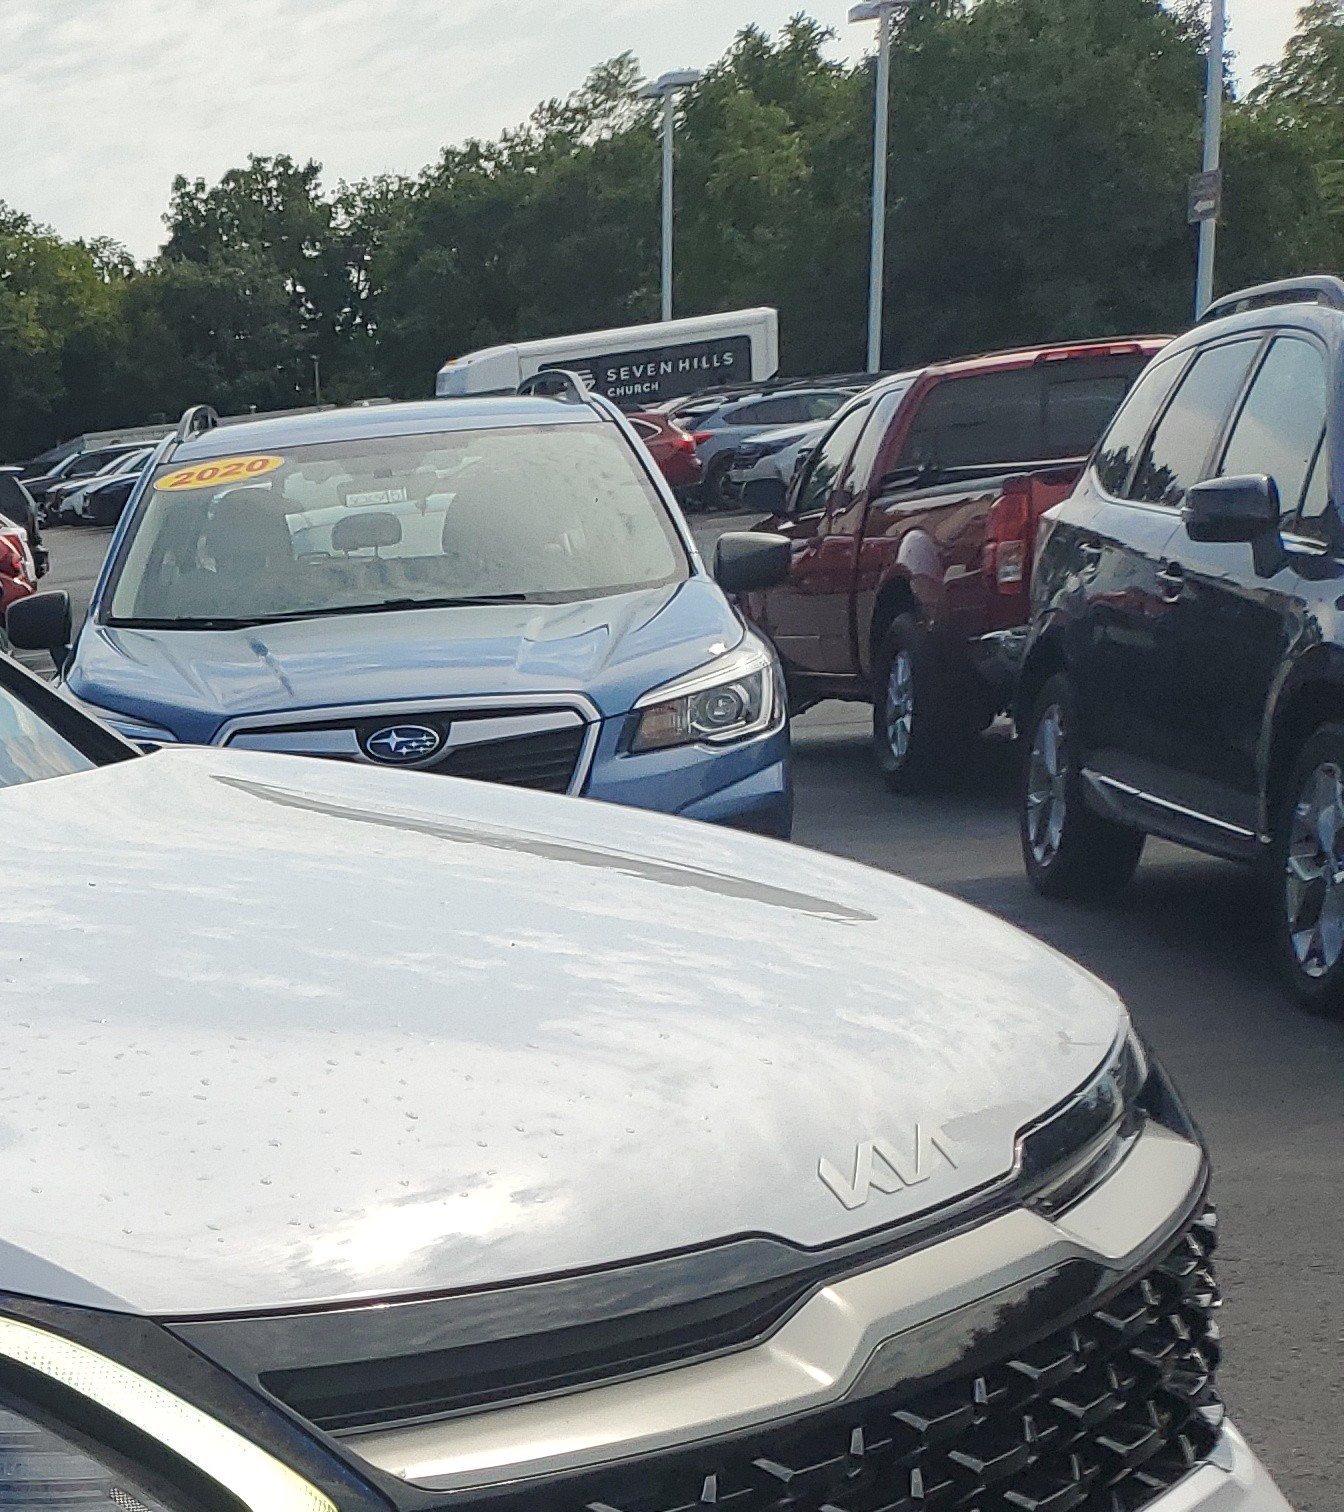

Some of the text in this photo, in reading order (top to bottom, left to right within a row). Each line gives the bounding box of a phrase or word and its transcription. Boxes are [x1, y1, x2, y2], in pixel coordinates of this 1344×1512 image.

[606, 352, 734, 382] SEVEN HILLS
[607, 381, 660, 397] CHURCH
[169, 458, 269, 488] 2020
[817, 1122, 959, 1211] KIA
